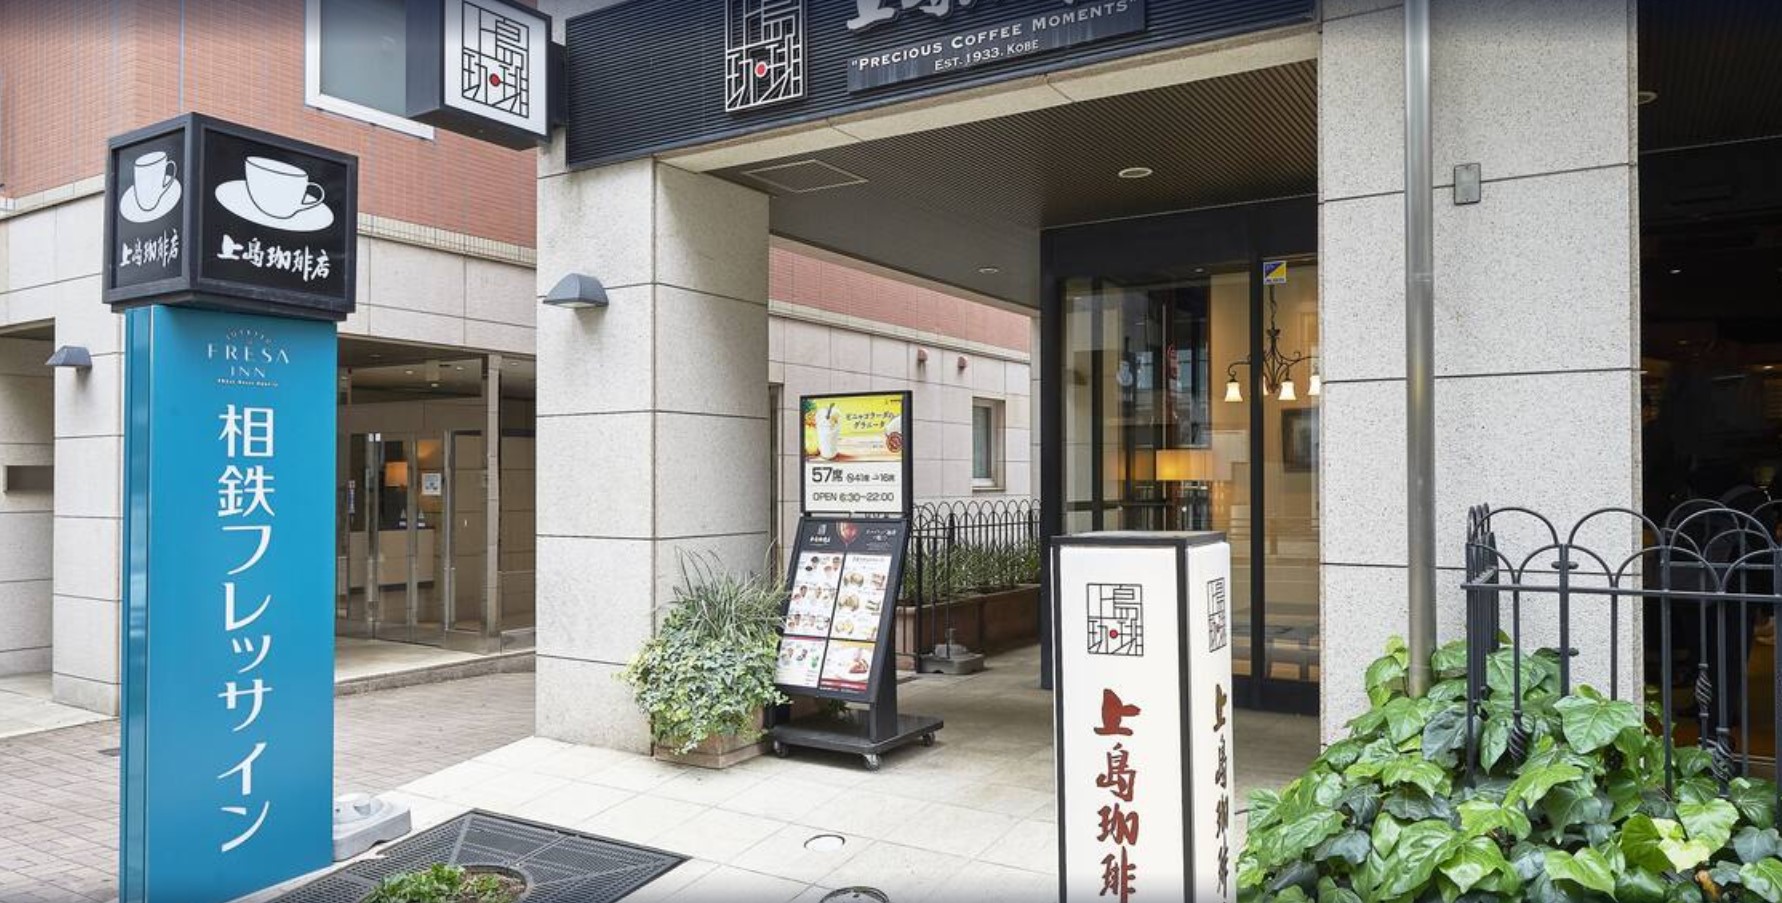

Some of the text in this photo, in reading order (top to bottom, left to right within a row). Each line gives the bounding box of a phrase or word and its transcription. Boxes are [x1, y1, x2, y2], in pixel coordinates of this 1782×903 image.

[851, 42, 943, 72] "PRECIOUS
[951, 23, 1022, 49] COFFEE
[934, 57, 964, 72] EST.
[1006, 39, 1039, 55] KOBE
[119, 228, 181, 269] 上島珈琲店
[217, 234, 332, 282] 上島珈琲店
[206, 343, 290, 365] FRESA
[230, 366, 266, 378] INN
[813, 492, 837, 502] OPEN
[217, 403, 276, 853] 相鉄フレッサイン
[1093, 688, 1142, 903] 上島珈琲
